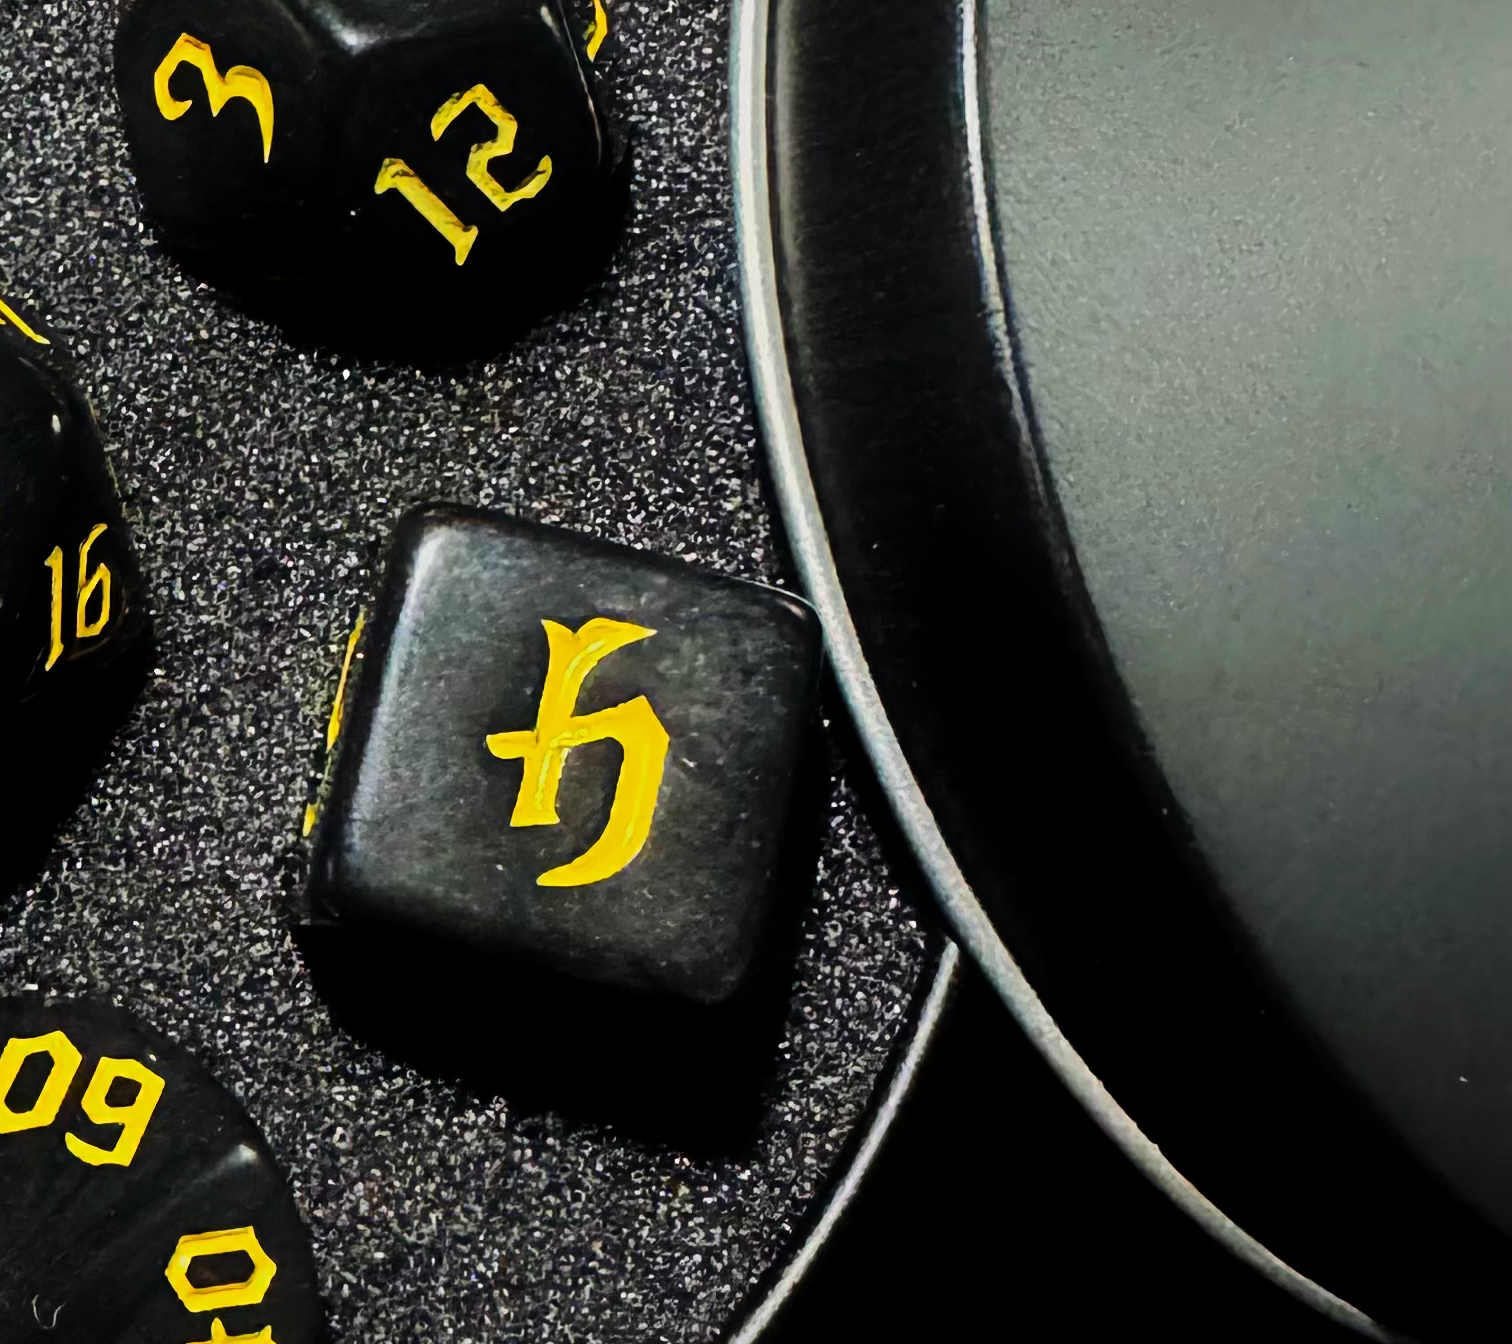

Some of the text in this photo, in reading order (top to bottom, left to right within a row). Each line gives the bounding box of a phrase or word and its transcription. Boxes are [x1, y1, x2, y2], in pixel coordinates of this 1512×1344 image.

[154, 33, 274, 163] 3
[374, 84, 552, 266] 12
[45, 523, 111, 670] 16
[486, 617, 670, 887] 4
